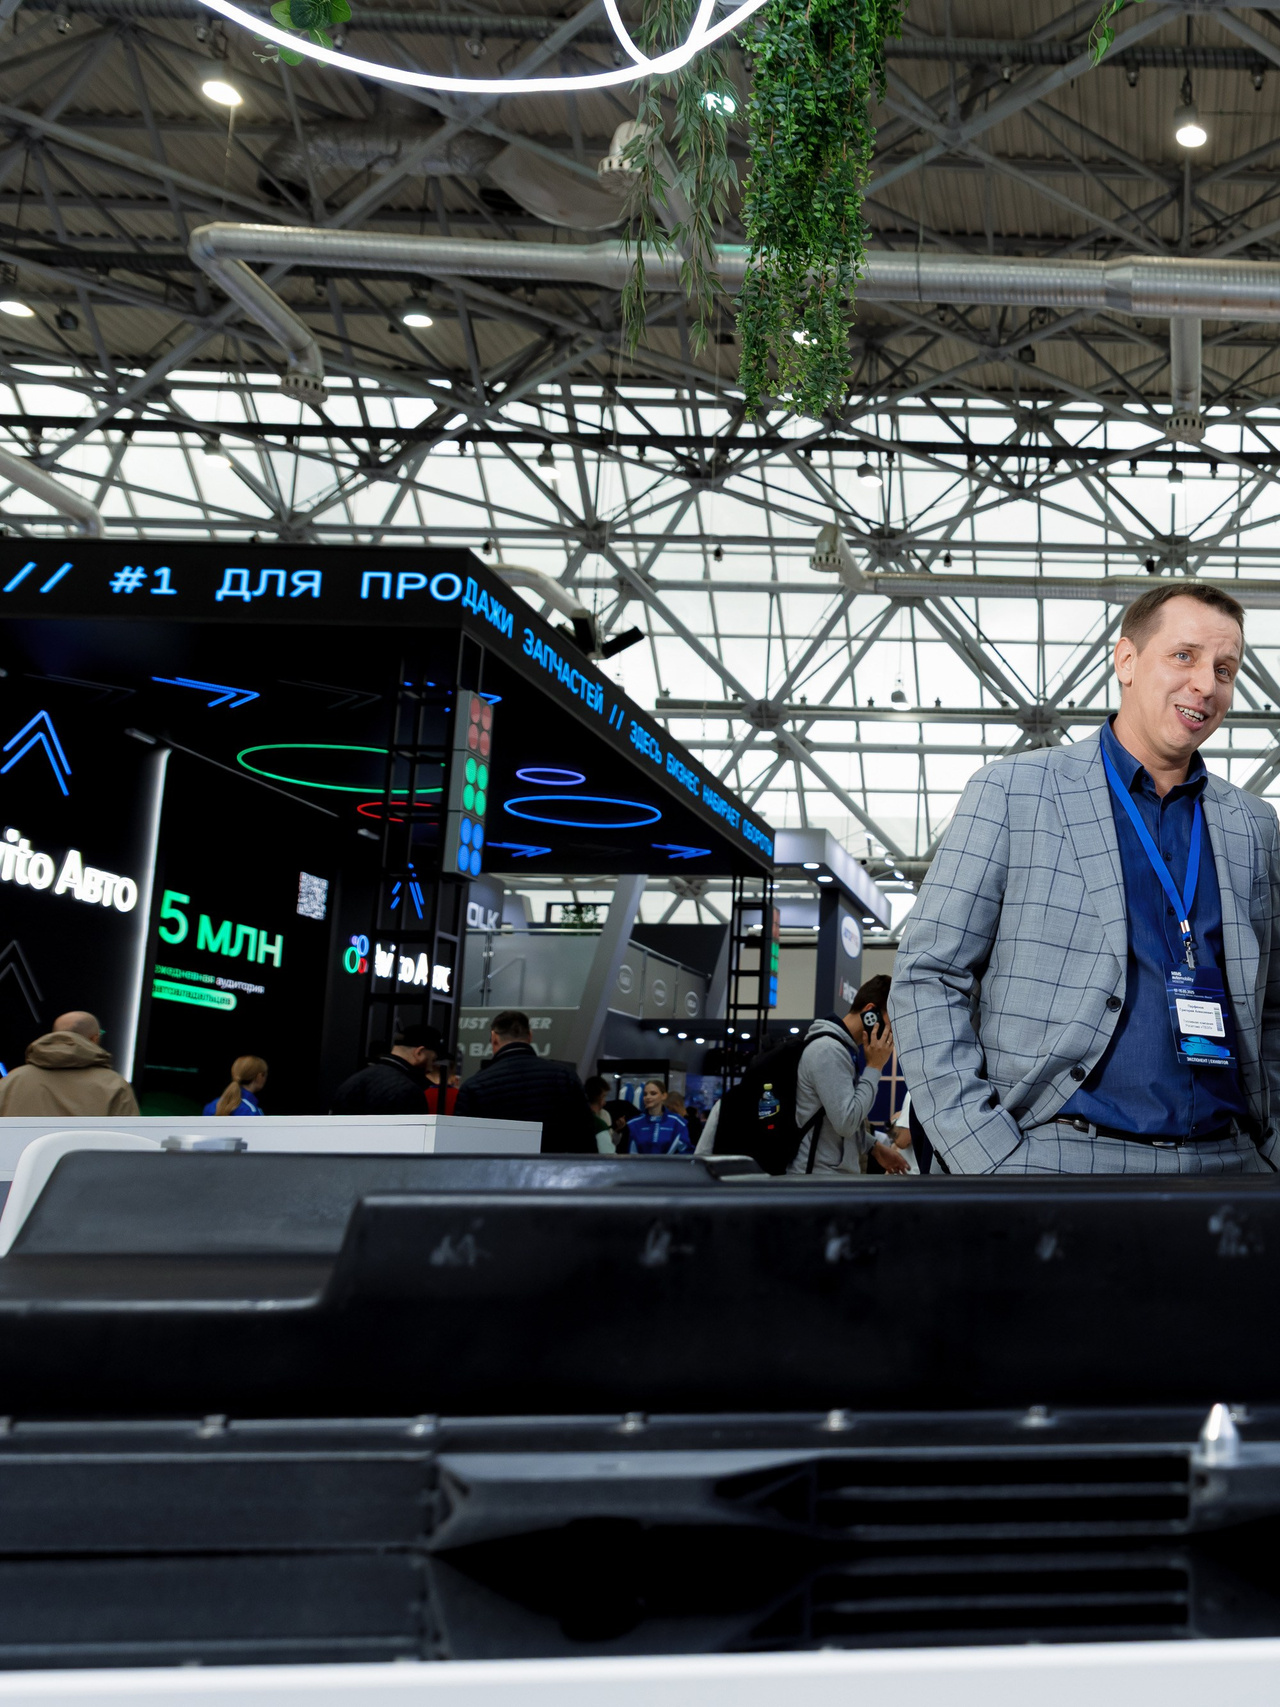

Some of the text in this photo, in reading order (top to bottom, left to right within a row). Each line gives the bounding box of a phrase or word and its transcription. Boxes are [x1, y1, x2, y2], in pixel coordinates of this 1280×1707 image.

[109, 565, 177, 595] #1
[215, 568, 323, 602] ДЛЯ
[361, 571, 514, 639] ПРОДАЖИ
[522, 628, 604, 714] ЗАПЧАСТЕЙ
[629, 720, 663, 765] ЗДЕСЬ
[666, 752, 700, 797] БИЗНЕС
[158, 889, 191, 944] 5
